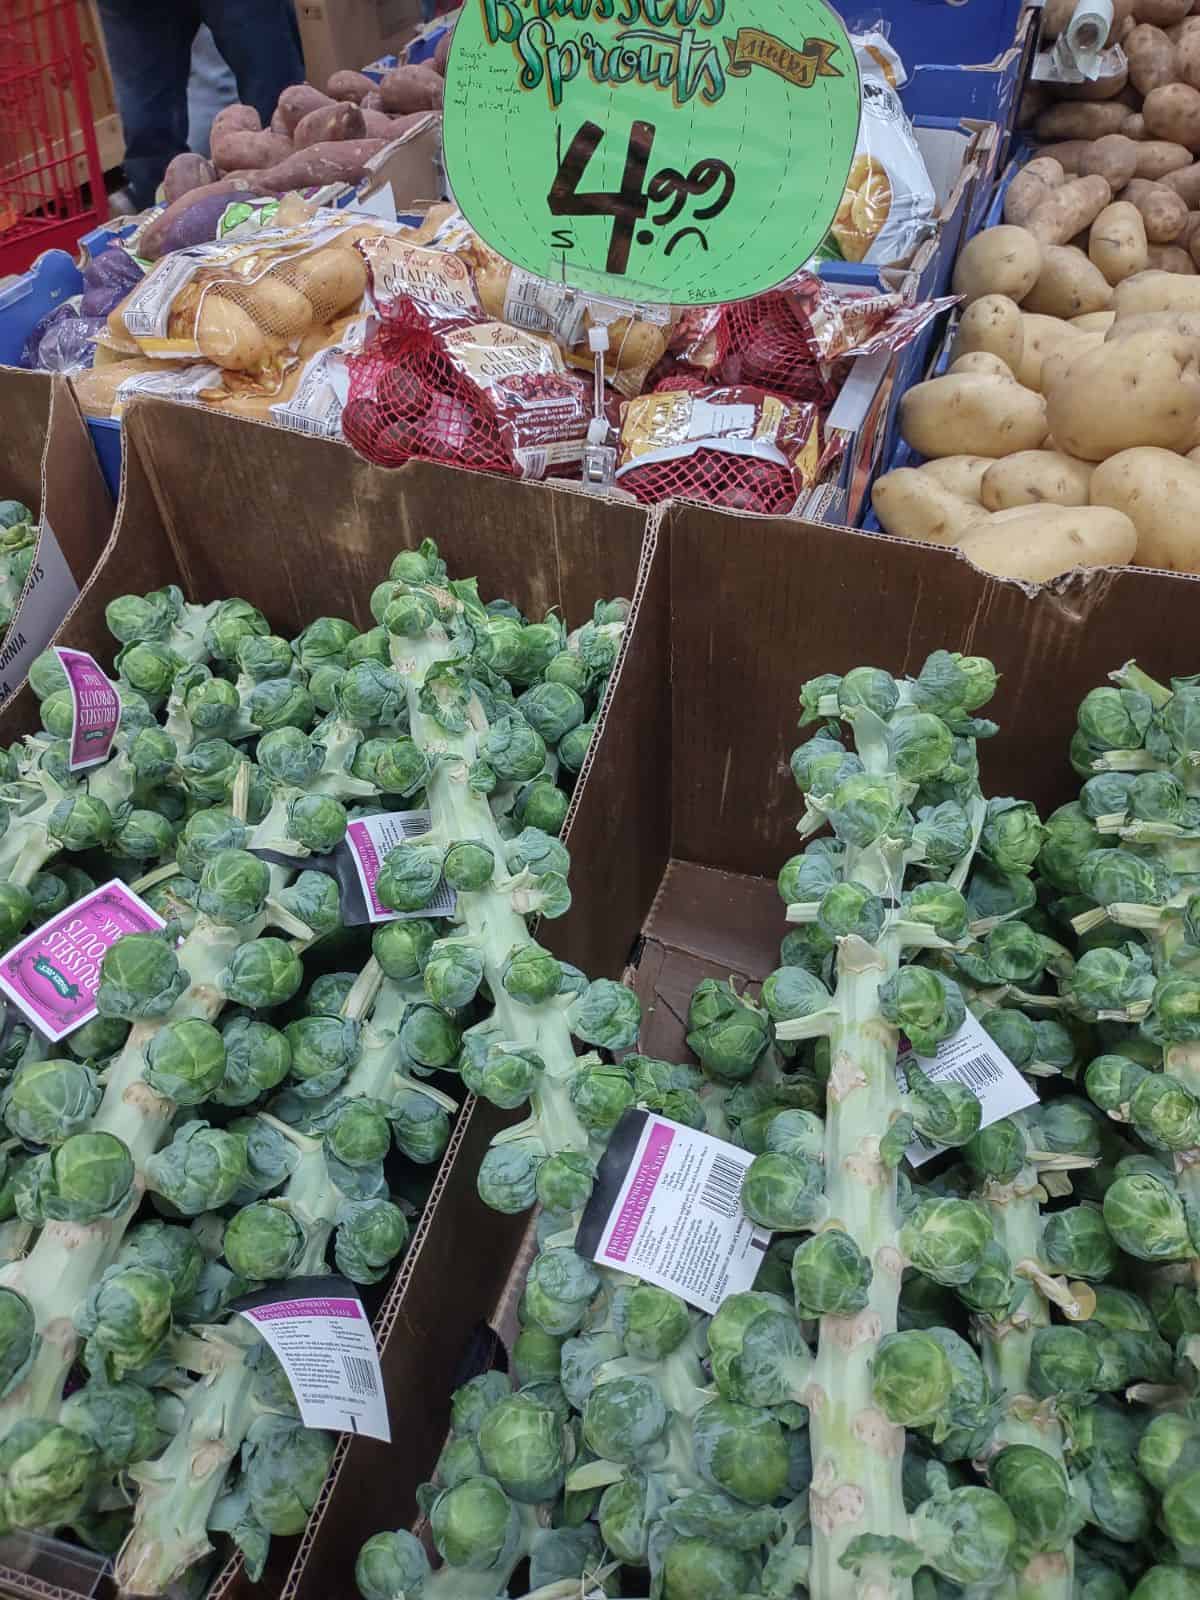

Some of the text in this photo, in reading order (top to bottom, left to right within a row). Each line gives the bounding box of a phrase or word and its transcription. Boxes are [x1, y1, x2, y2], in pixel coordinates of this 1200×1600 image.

[517, 16, 726, 106] Sprouts
[688, 288, 718, 300] EACH
[79, 690, 116, 706] SPROUTS
[42, 931, 101, 996] RUSSELS
